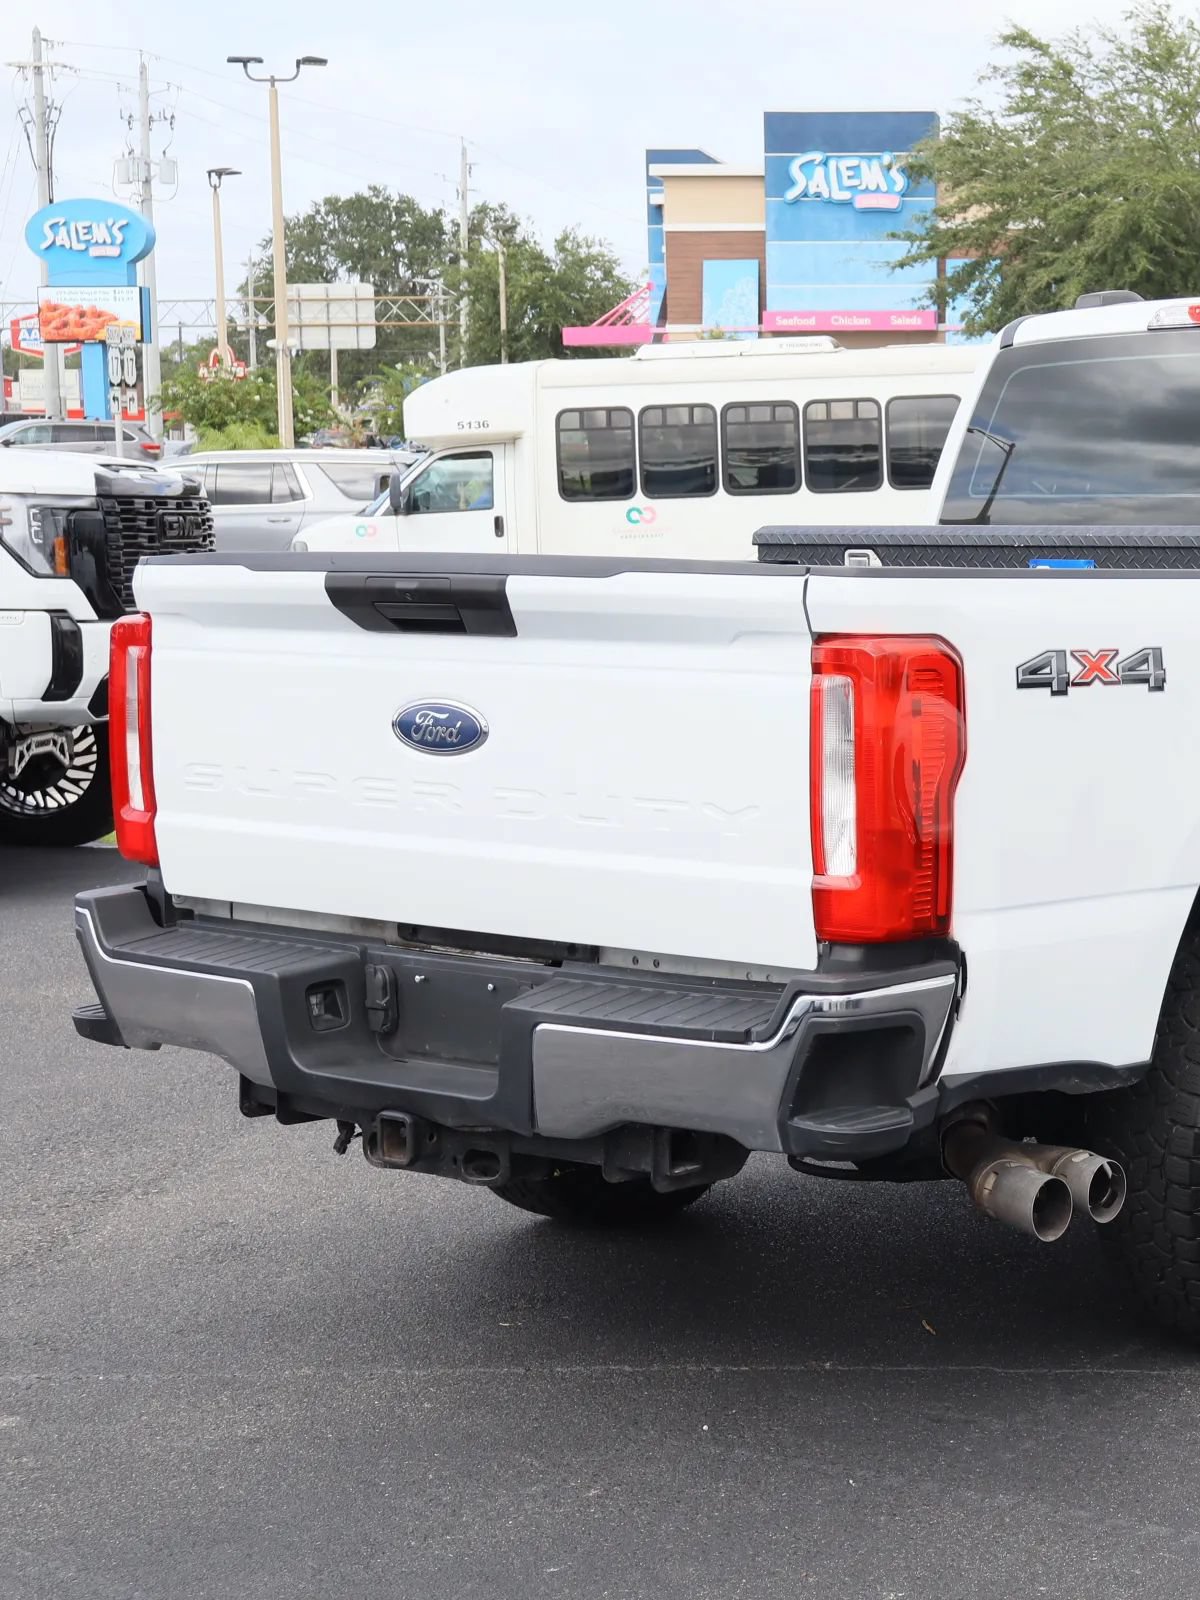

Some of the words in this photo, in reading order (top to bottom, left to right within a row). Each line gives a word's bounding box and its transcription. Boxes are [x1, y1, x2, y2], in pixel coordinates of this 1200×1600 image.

[40, 216, 129, 251] SALEM'S
[775, 315, 816, 327] Seafood
[831, 315, 871, 326] Chicken
[890, 315, 922, 326] Salads
[111, 356, 119, 377] 17
[126, 357, 134, 378] 17
[456, 419, 491, 431] 5136
[411, 710, 462, 743] Ford
